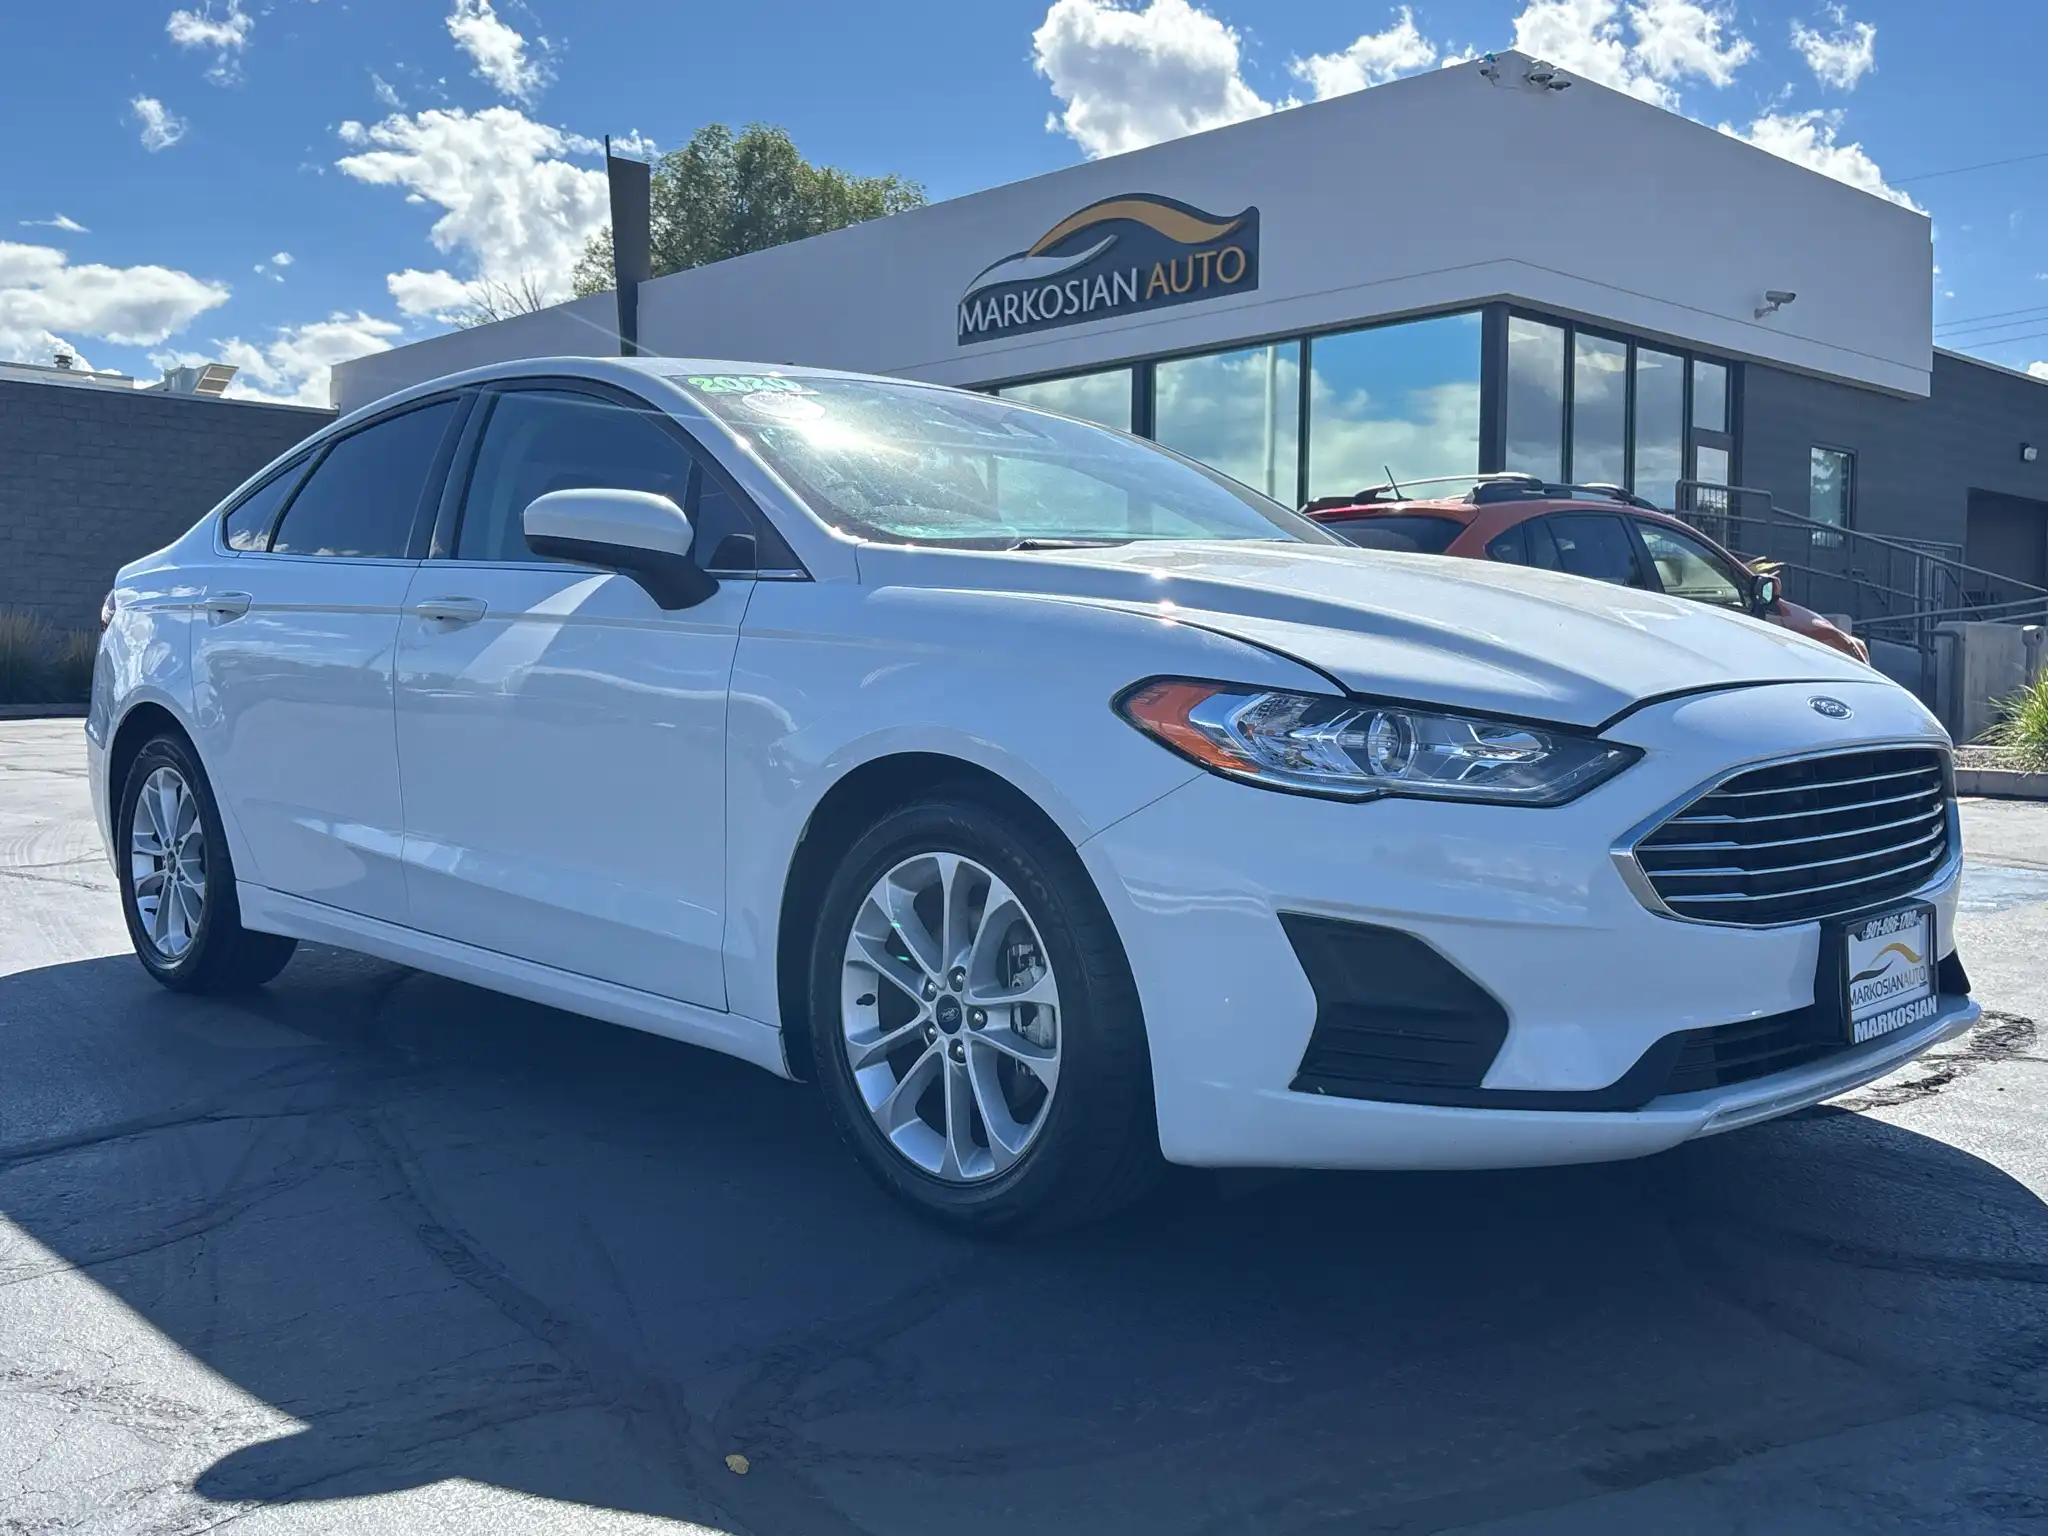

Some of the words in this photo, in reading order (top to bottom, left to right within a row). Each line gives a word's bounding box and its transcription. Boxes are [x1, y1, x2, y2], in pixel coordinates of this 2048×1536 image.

[958, 267, 1138, 336] MARKOSIAN
[1145, 246, 1247, 299] AUTO
[687, 376, 802, 393] 2020
[1853, 995, 1938, 1044] MARKOSIAN
